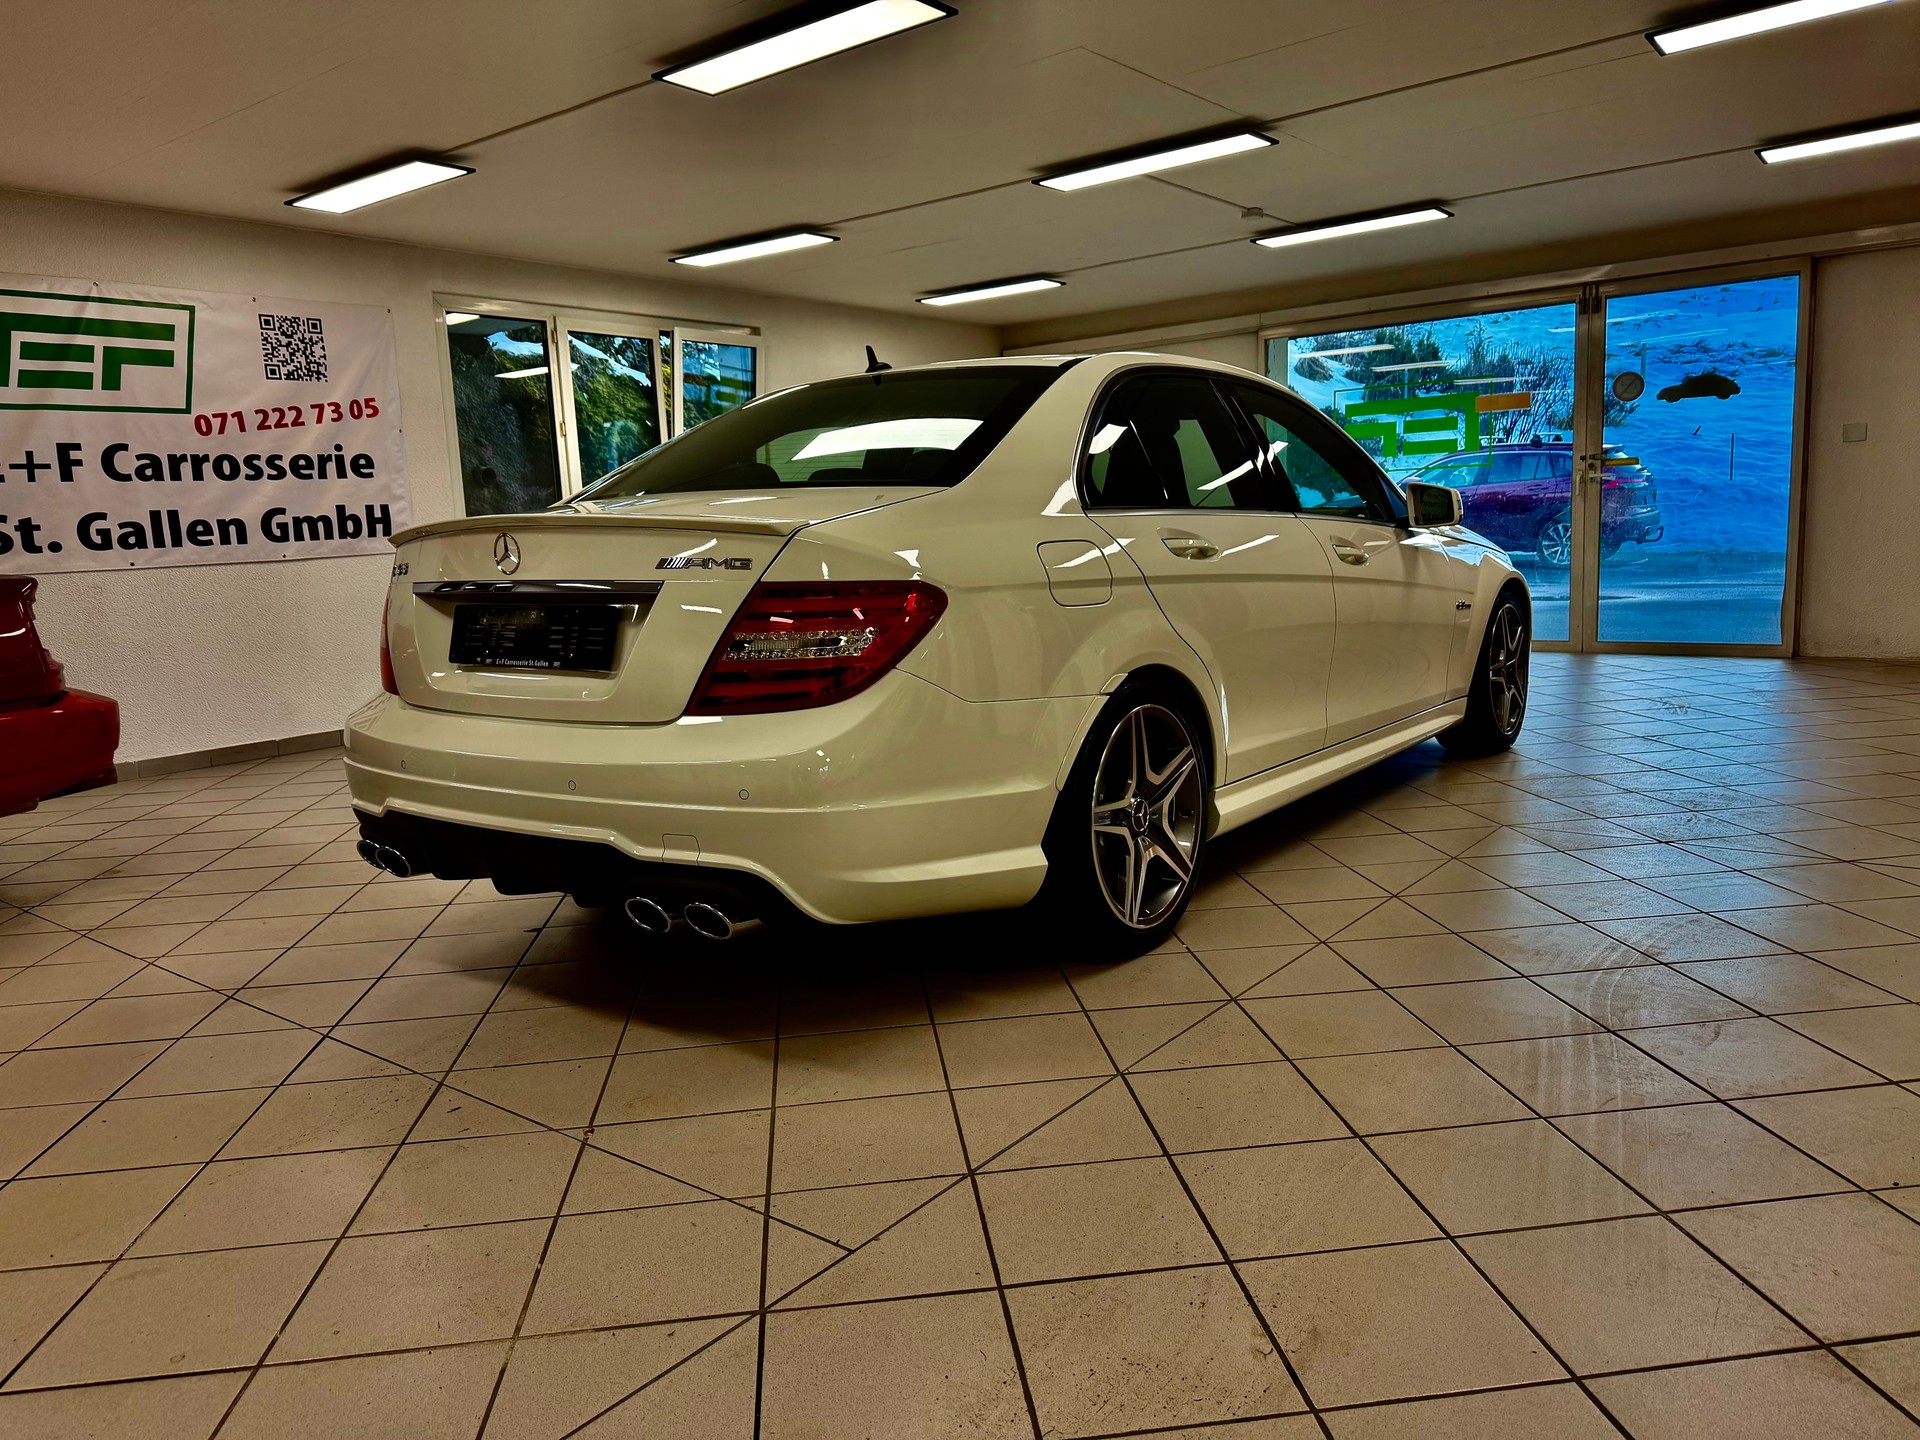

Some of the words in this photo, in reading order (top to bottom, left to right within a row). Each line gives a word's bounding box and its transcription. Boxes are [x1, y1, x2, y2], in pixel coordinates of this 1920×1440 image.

[193, 410, 247, 437] 071
[254, 405, 306, 431] 222
[309, 401, 344, 425] 73
[349, 397, 380, 420] 05
[0, 442, 84, 484] +F
[100, 442, 375, 483] Carrosserie
[0, 514, 63, 556] St.
[76, 509, 249, 552] Gallen
[260, 502, 393, 543] GmbH
[683, 557, 752, 570] AMG
